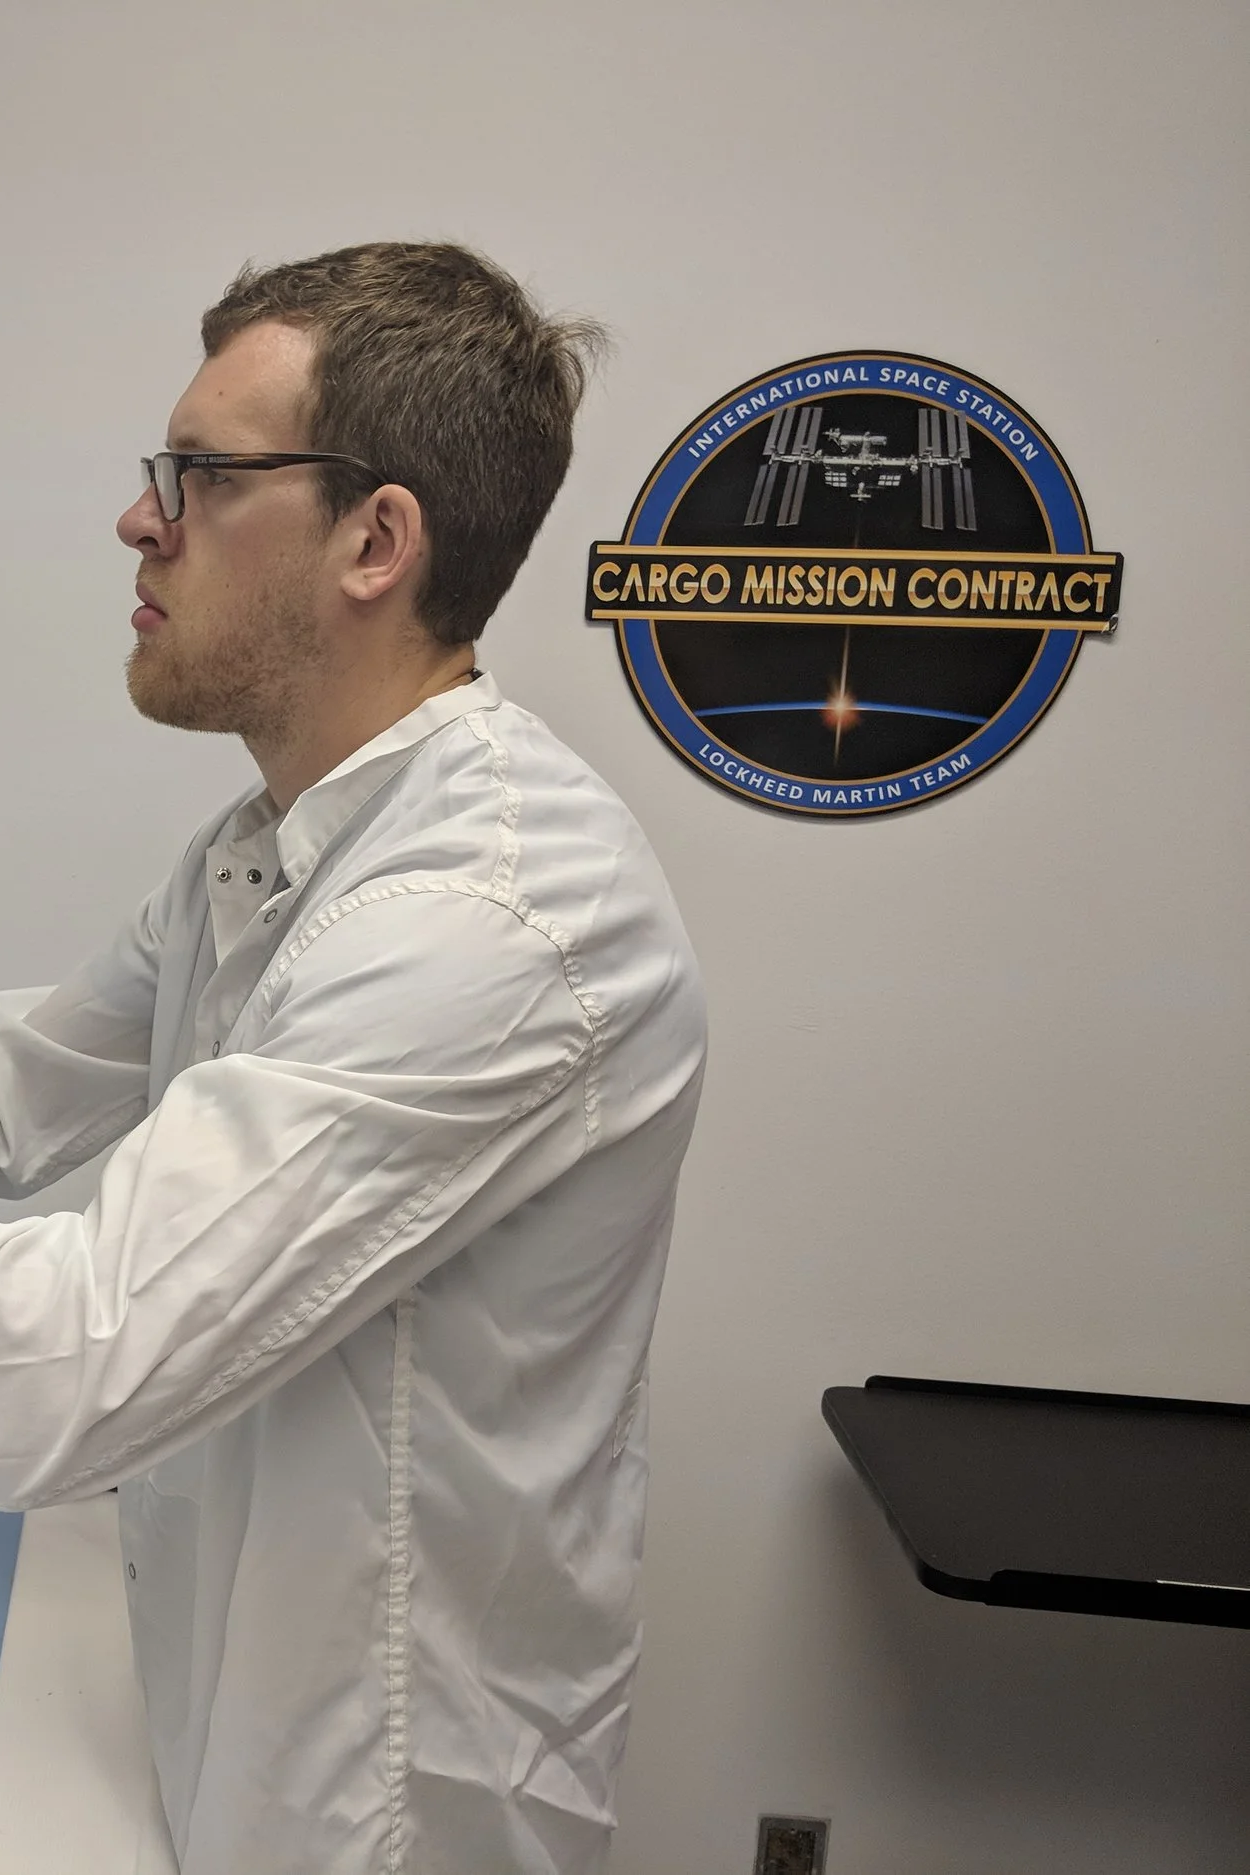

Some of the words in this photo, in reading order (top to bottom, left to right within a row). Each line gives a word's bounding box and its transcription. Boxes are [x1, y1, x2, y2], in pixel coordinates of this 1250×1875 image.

[688, 366, 870, 458] INTERNATIONAL
[879, 367, 950, 396] SPACE
[956, 389, 1039, 462] STATION
[592, 561, 731, 604] CARGO
[740, 564, 896, 608] MISSION
[908, 568, 1112, 614] CONTRACT
[698, 743, 804, 800] LOCKHEED
[812, 783, 902, 804] MARTIN
[909, 753, 972, 791] TEAM
